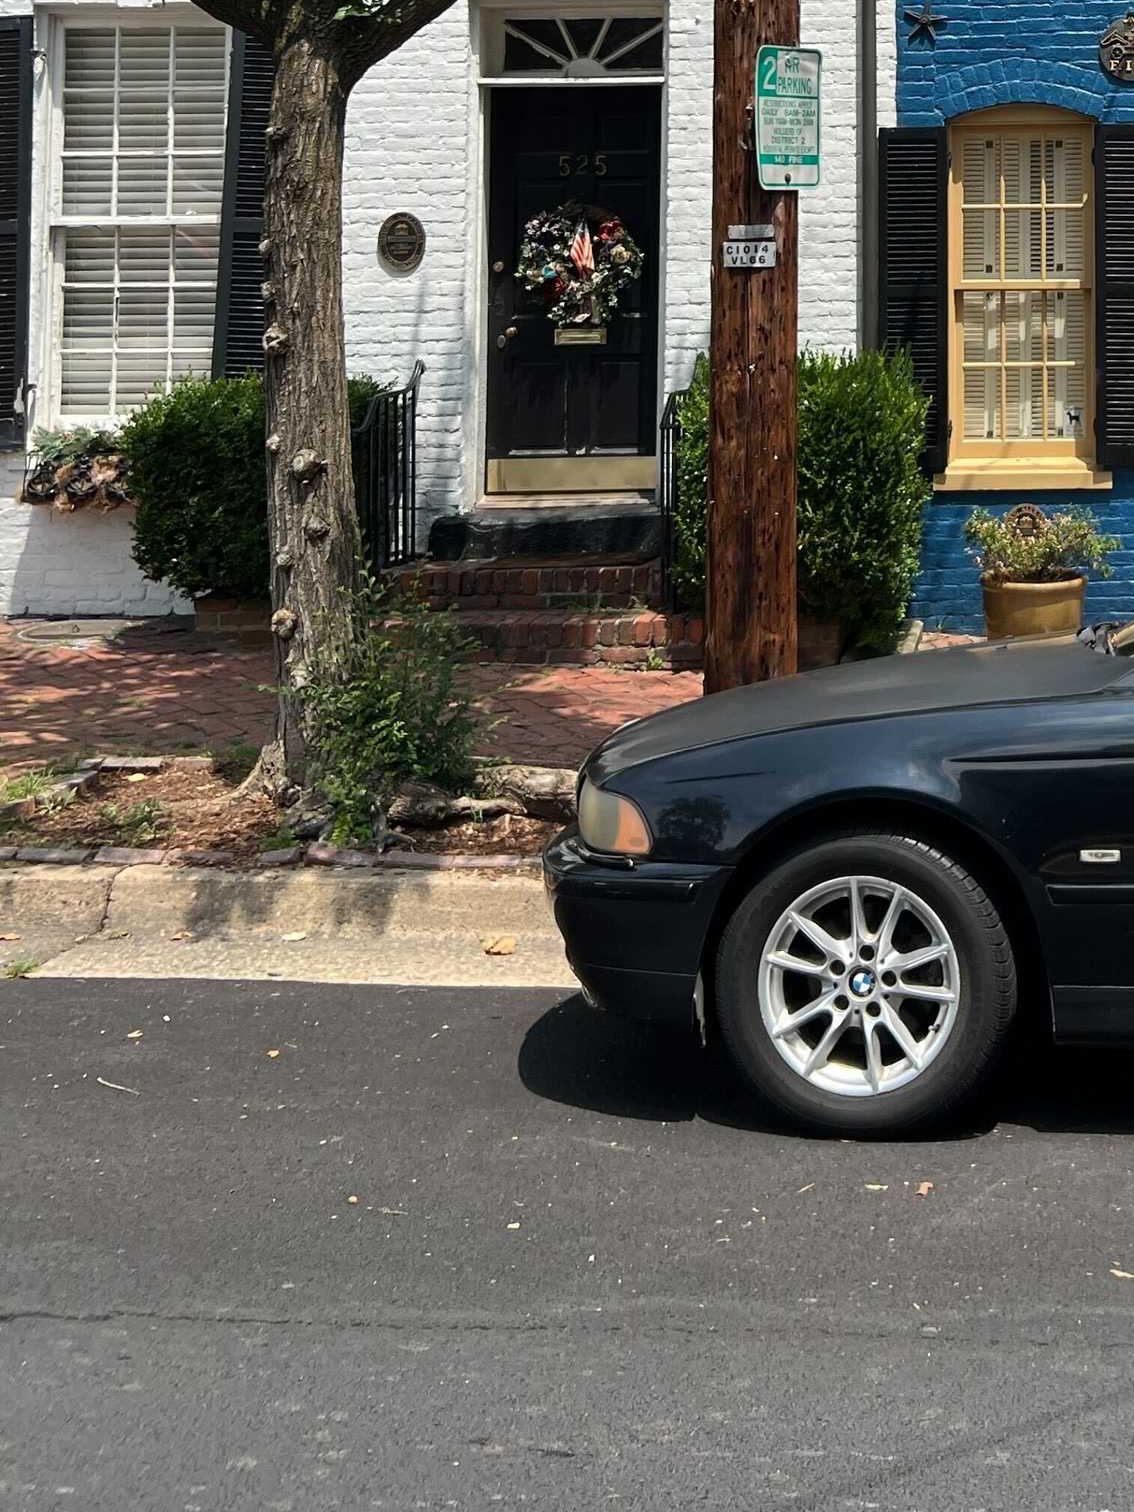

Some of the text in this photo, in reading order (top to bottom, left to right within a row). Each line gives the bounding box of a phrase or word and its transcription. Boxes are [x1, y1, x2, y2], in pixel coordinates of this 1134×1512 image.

[763, 56, 776, 89] 2
[778, 77, 812, 95] PARKING
[559, 155, 608, 177] 525
